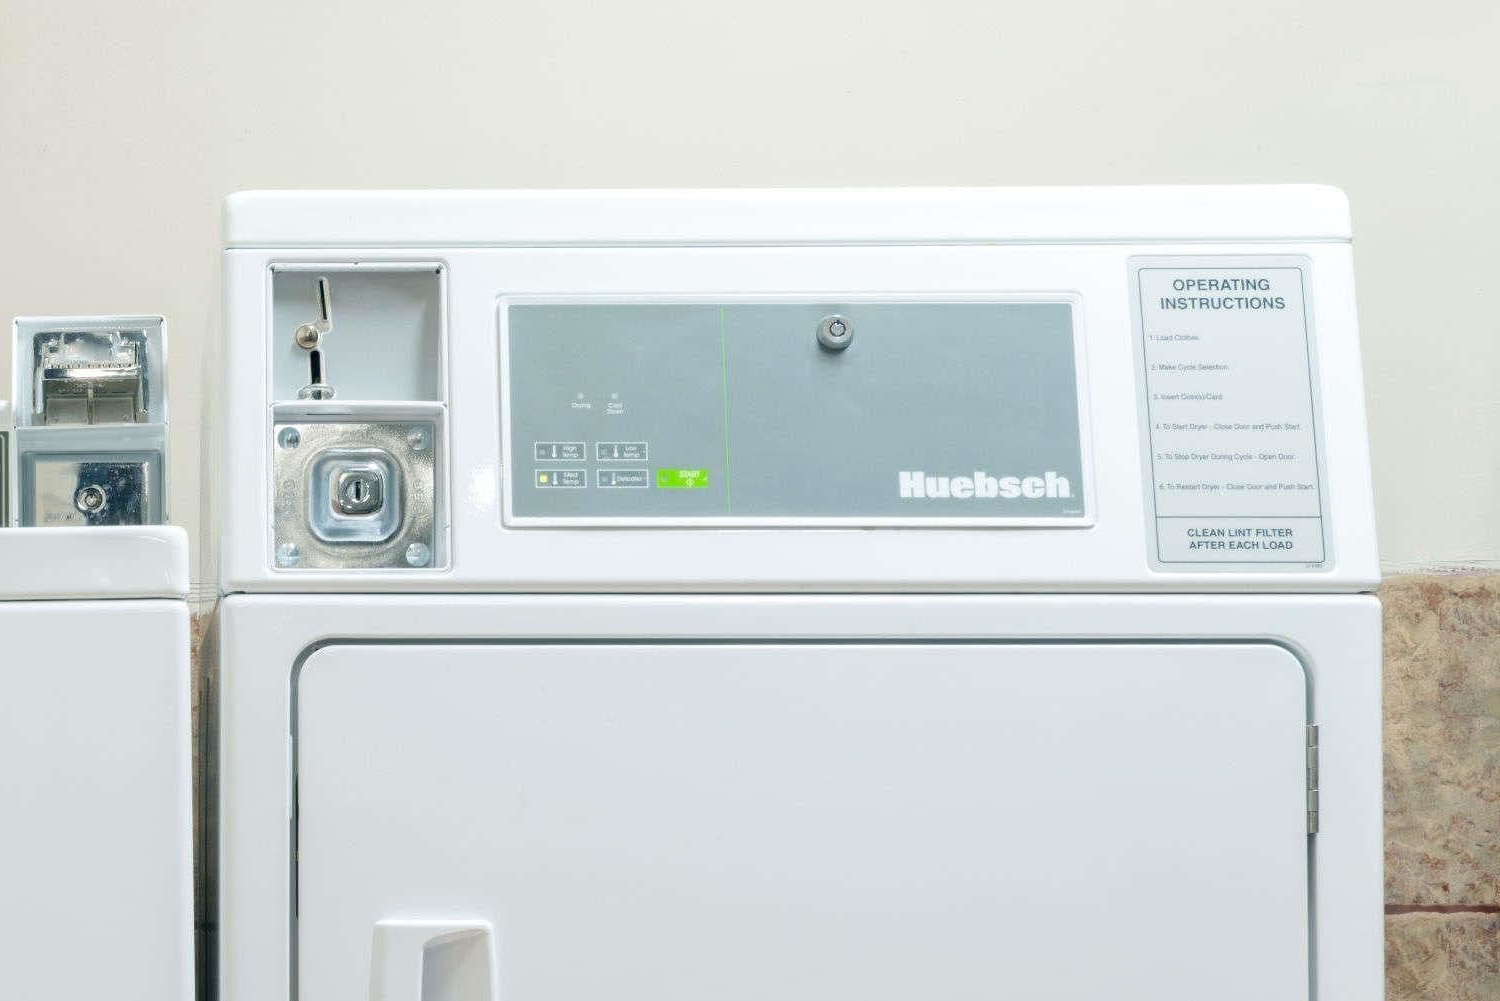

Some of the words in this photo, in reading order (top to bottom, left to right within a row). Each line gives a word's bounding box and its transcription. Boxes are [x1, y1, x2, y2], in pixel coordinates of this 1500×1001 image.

[1172, 278, 1270, 291] OPERATING
[1160, 297, 1285, 310] INSTRUCTIONS
[1178, 364, 1197, 373] Cycle
[899, 471, 1070, 498] Huebsch
[1187, 528, 1225, 537] CLEAN
[1228, 528, 1253, 537] LINT
[1256, 528, 1293, 537] FILTER
[1189, 541, 1225, 550] AFTER
[1229, 541, 1259, 550] EACH
[1262, 541, 1293, 550] LOAD
